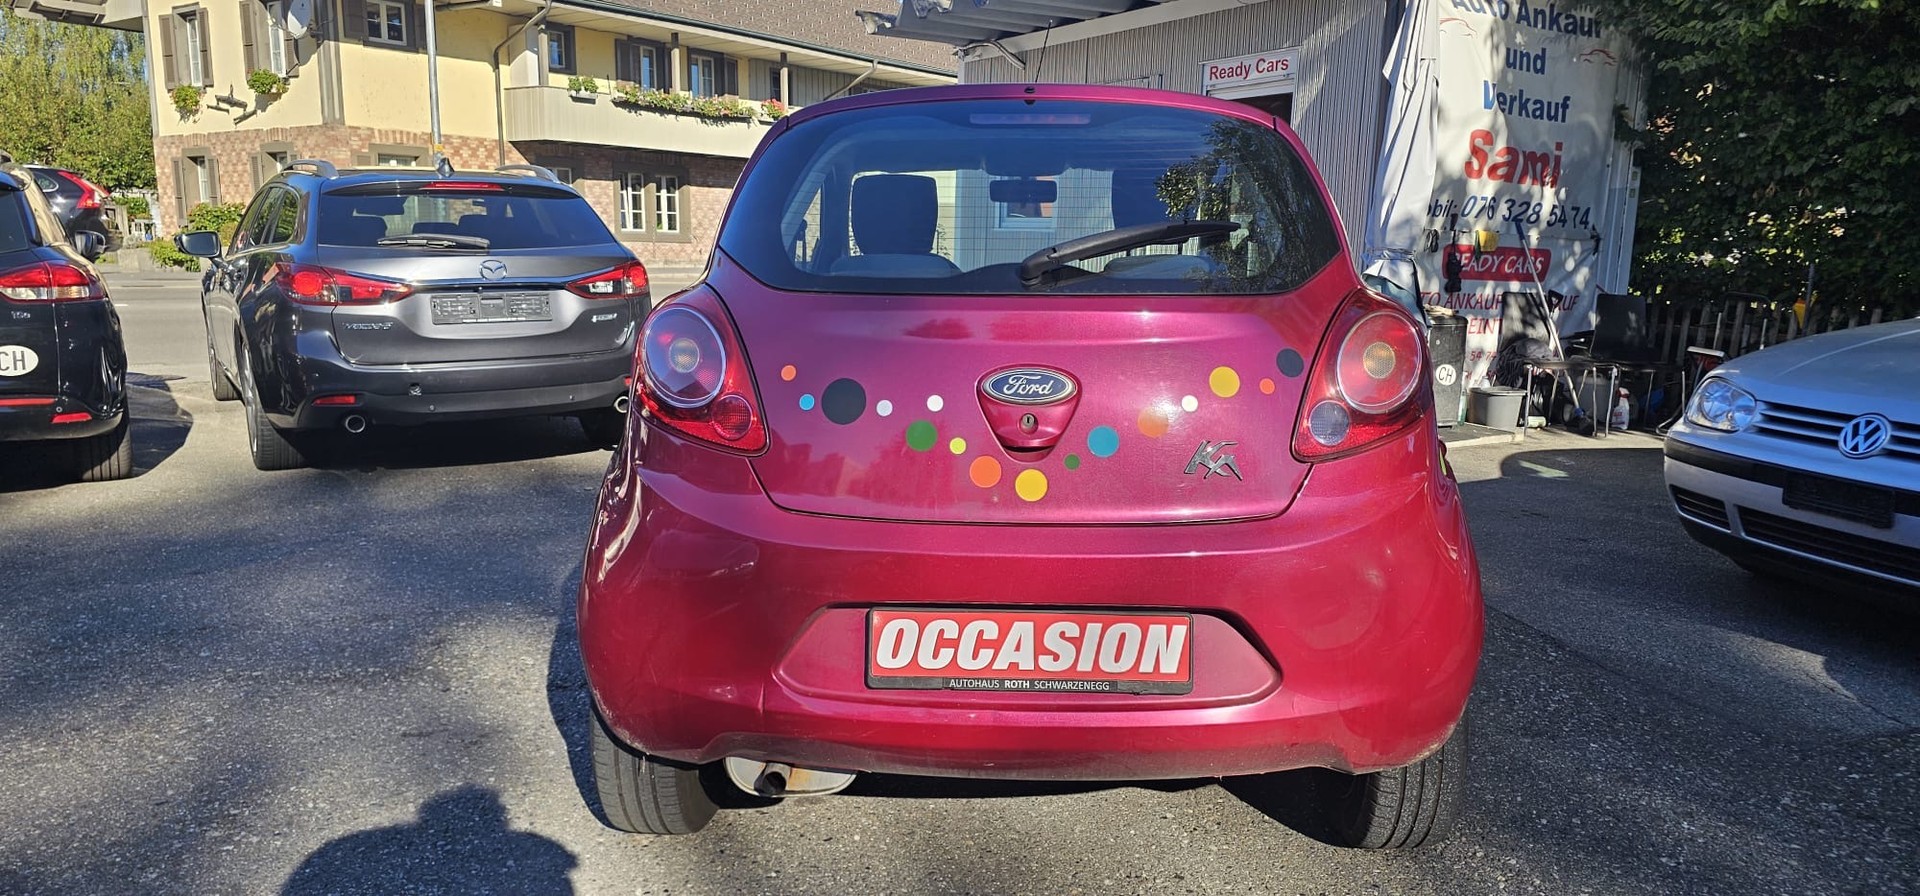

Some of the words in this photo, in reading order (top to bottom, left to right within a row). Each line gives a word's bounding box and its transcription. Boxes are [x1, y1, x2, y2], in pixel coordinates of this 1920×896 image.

[1209, 61, 1252, 81] Ready
[1255, 57, 1290, 74] Cars
[1505, 47, 1546, 75] und
[1483, 79, 1572, 123] Verkauf
[1464, 128, 1564, 189] Sami
[1460, 194, 1497, 221] 076
[1502, 198, 1543, 224] 328
[1504, 255, 1545, 275] CARS
[1002, 373, 1054, 396] Ford
[1438, 366, 1453, 382] CH
[875, 617, 1189, 675] OCCASION
[949, 678, 1000, 691] AUTOHAUS
[1004, 679, 1030, 691] ROTH
[1034, 680, 1110, 692] SCHWARZENEGG
